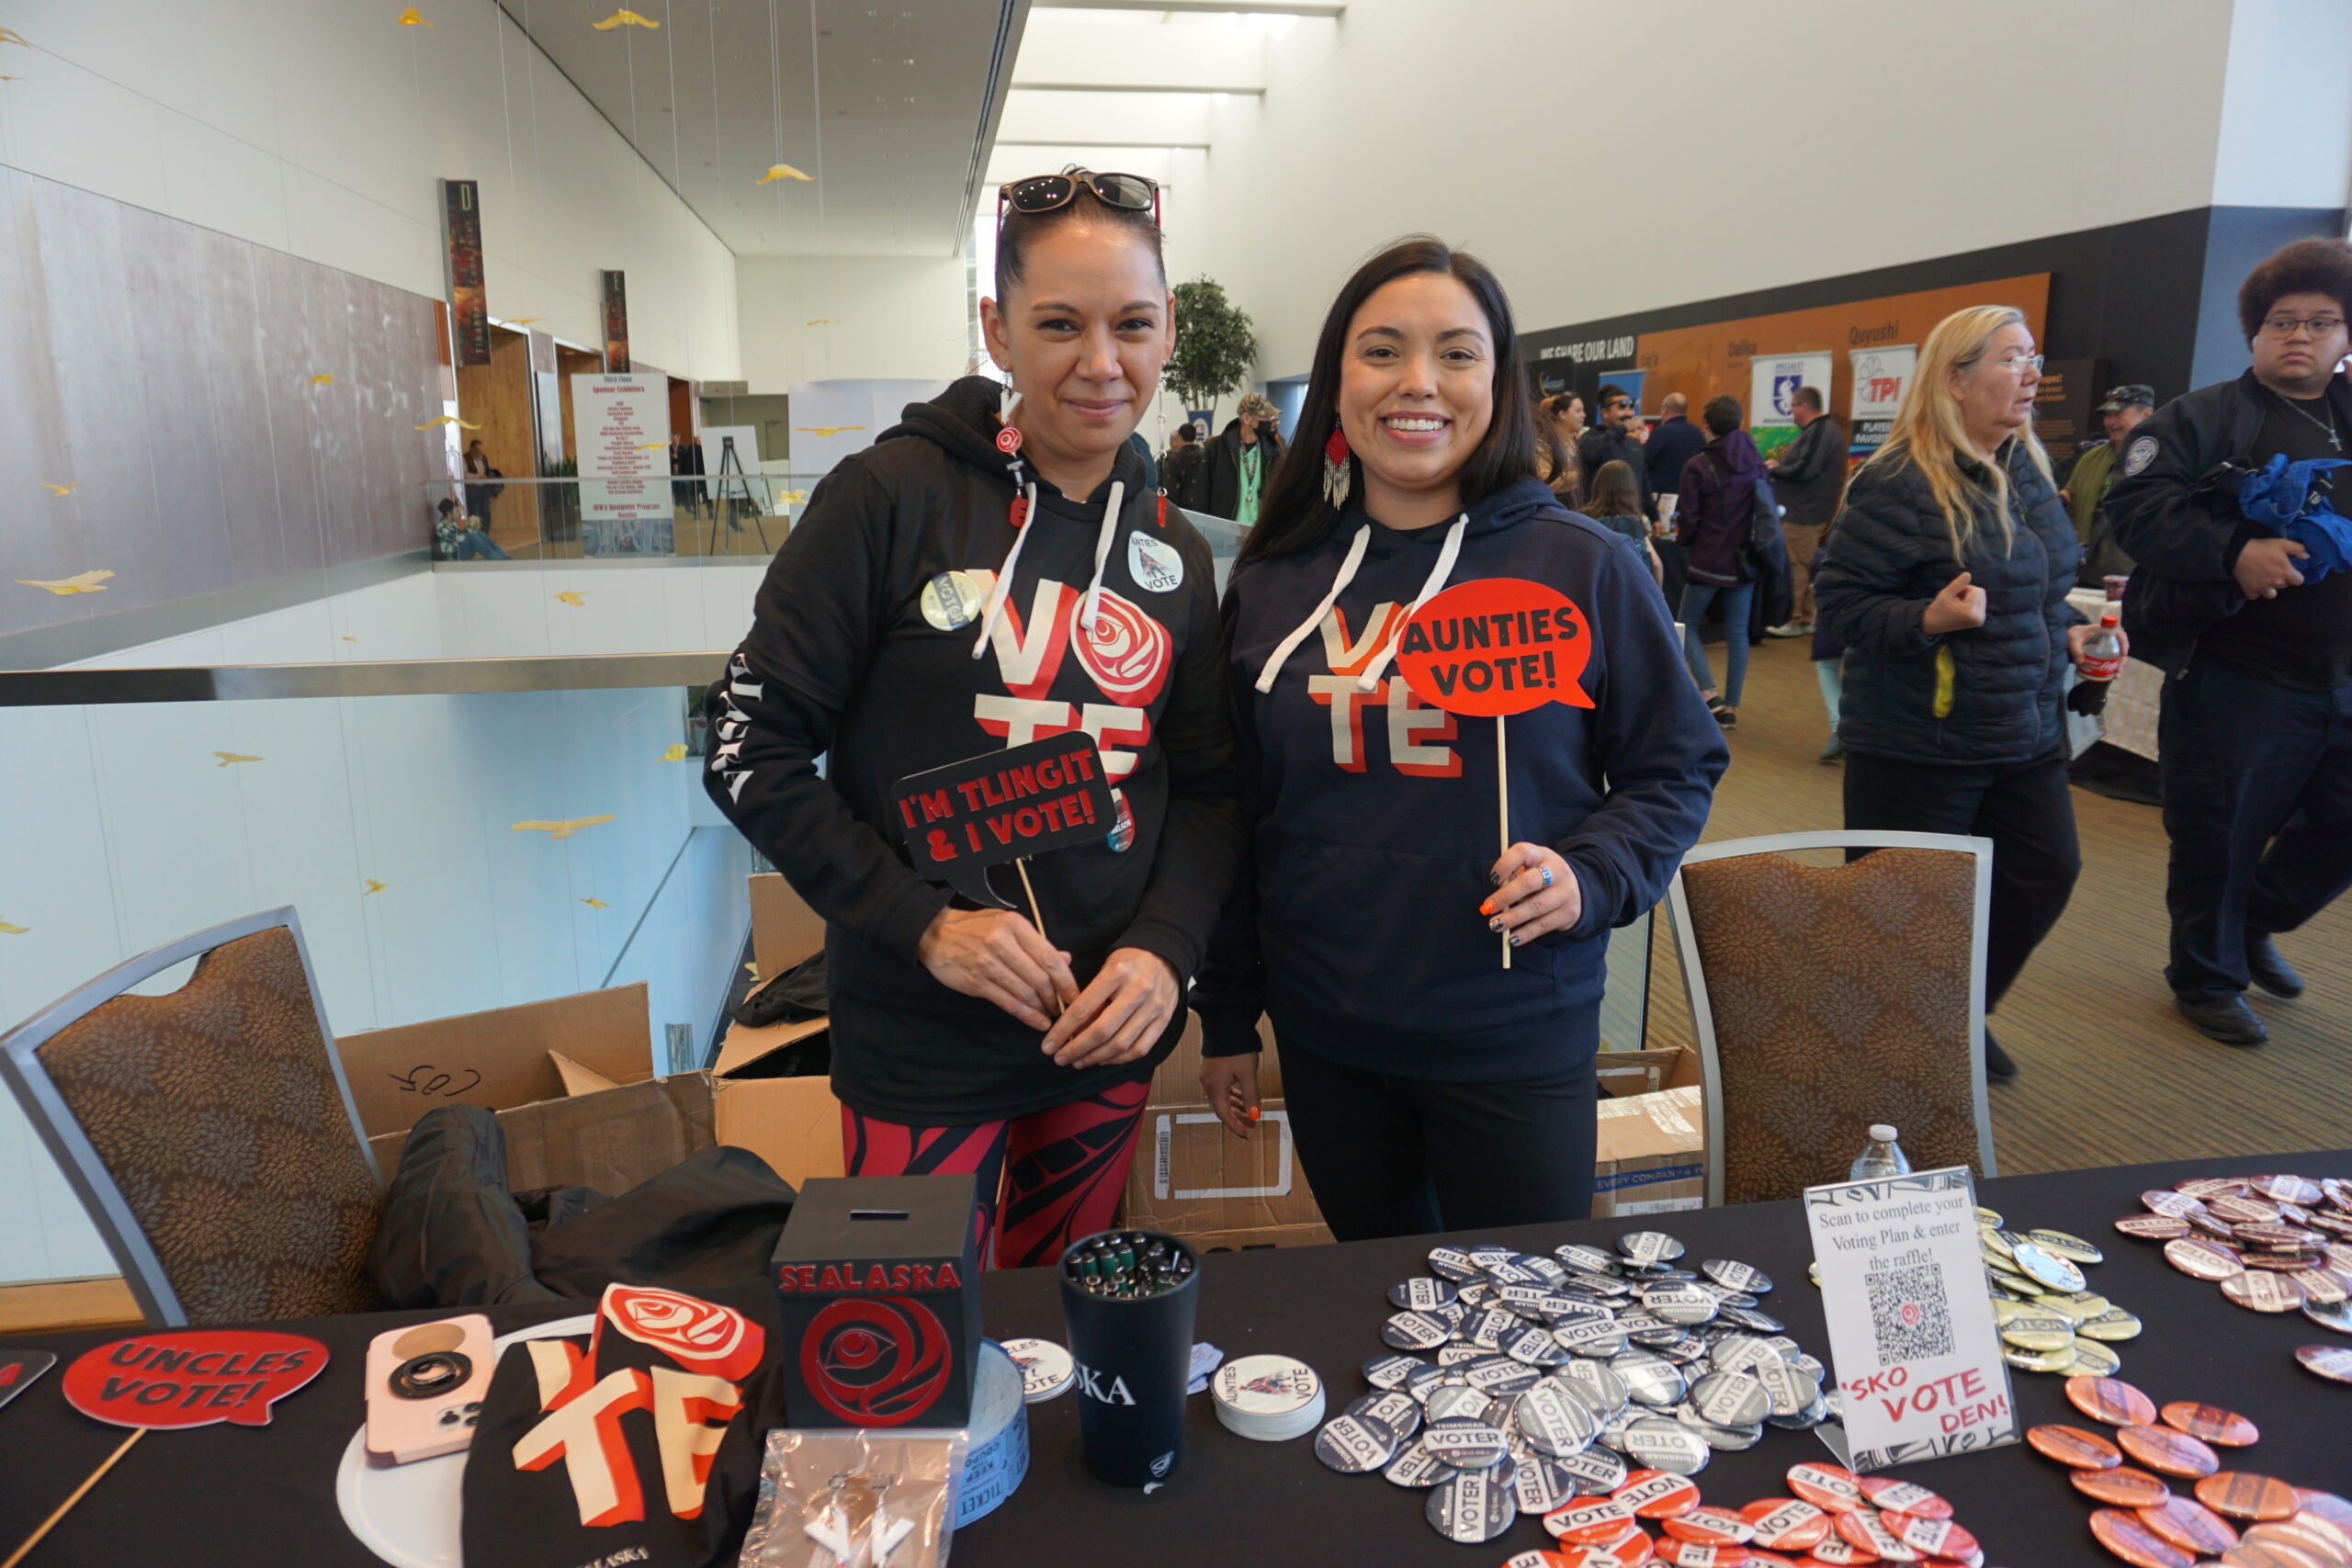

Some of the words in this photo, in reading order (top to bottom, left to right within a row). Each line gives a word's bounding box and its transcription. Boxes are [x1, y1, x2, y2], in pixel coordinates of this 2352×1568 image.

[1849, 321, 1899, 345] Quyushi
[1585, 340, 1606, 362] OUR
[1607, 335, 1634, 359] LAND
[593, 386, 616, 394] Sponsor
[1868, 377, 1902, 403] TPI
[636, 502, 661, 512] Program
[1143, 575, 1178, 591] VOTE
[1401, 605, 1578, 657] AUNTIES
[1430, 649, 1557, 697] VOTE!
[899, 788, 955, 829] I'M
[957, 748, 1094, 812] TLINGIT
[926, 829, 959, 862] &
[964, 822, 983, 852] I
[985, 788, 1096, 845] VOTE!
[1598, 1176, 1631, 1190] EVERY
[1632, 1169, 1682, 1184] COMPANY
[1819, 1213, 1852, 1229] Scan
[1856, 1211, 1869, 1223] to
[1872, 1201, 1931, 1222] complete
[1935, 1196, 1963, 1215] your
[1832, 1234, 1877, 1252] Voting
[1880, 1228, 1910, 1245] Plan
[1913, 1224, 1926, 1239] &
[1929, 1222, 1962, 1237] enter
[1436, 1250, 1465, 1264] TER
[1562, 1247, 1604, 1266] OTER
[1869, 1255, 1890, 1271] the
[1893, 1247, 1934, 1269] raffle!
[778, 1261, 962, 1292] SEALASKA
[1413, 1278, 1431, 1305] VOTER
[1507, 1289, 1537, 1299] TER
[1650, 1293, 1712, 1307] VOTER
[1395, 1314, 1439, 1342] VOTER
[1562, 1322, 1616, 1338] VOTER
[1622, 1317, 1659, 1329] VOT
[1007, 1339, 1039, 1356] CLES
[1518, 1331, 1546, 1356] VOTER
[107, 1341, 314, 1376] UNCLES
[98, 1375, 270, 1409] VOTE!
[1023, 1373, 1063, 1392] OTE
[1224, 1365, 1238, 1405] AUNTIES
[1292, 1367, 1312, 1402] VOTE
[1762, 1361, 1791, 1409] VOTER
[1880, 1367, 1987, 1423] VOTE
[1434, 1422, 1487, 1430] TSIMSHIAN
[1534, 1391, 1575, 1449] VOTER
[1939, 1393, 2010, 1435] DEN!
[1332, 1417, 1378, 1462] VOTER
[1430, 1431, 1500, 1446] VOTER
[1631, 1433, 1688, 1449] OTER
[965, 1439, 1001, 1468] COUPO
[965, 1461, 994, 1484] KEEP
[1518, 1460, 1544, 1506] VOTER
[1562, 1457, 1618, 1482] OTER
[1793, 1468, 1853, 1495] OTE
[960, 1481, 1002, 1517] TICKET
[1459, 1477, 1480, 1534] VOTER
[1621, 1477, 1686, 1508] VOTE
[1552, 1504, 1626, 1529] VOTE
[1683, 1512, 1742, 1535] VOT
[1756, 1502, 1815, 1536] VOTE
